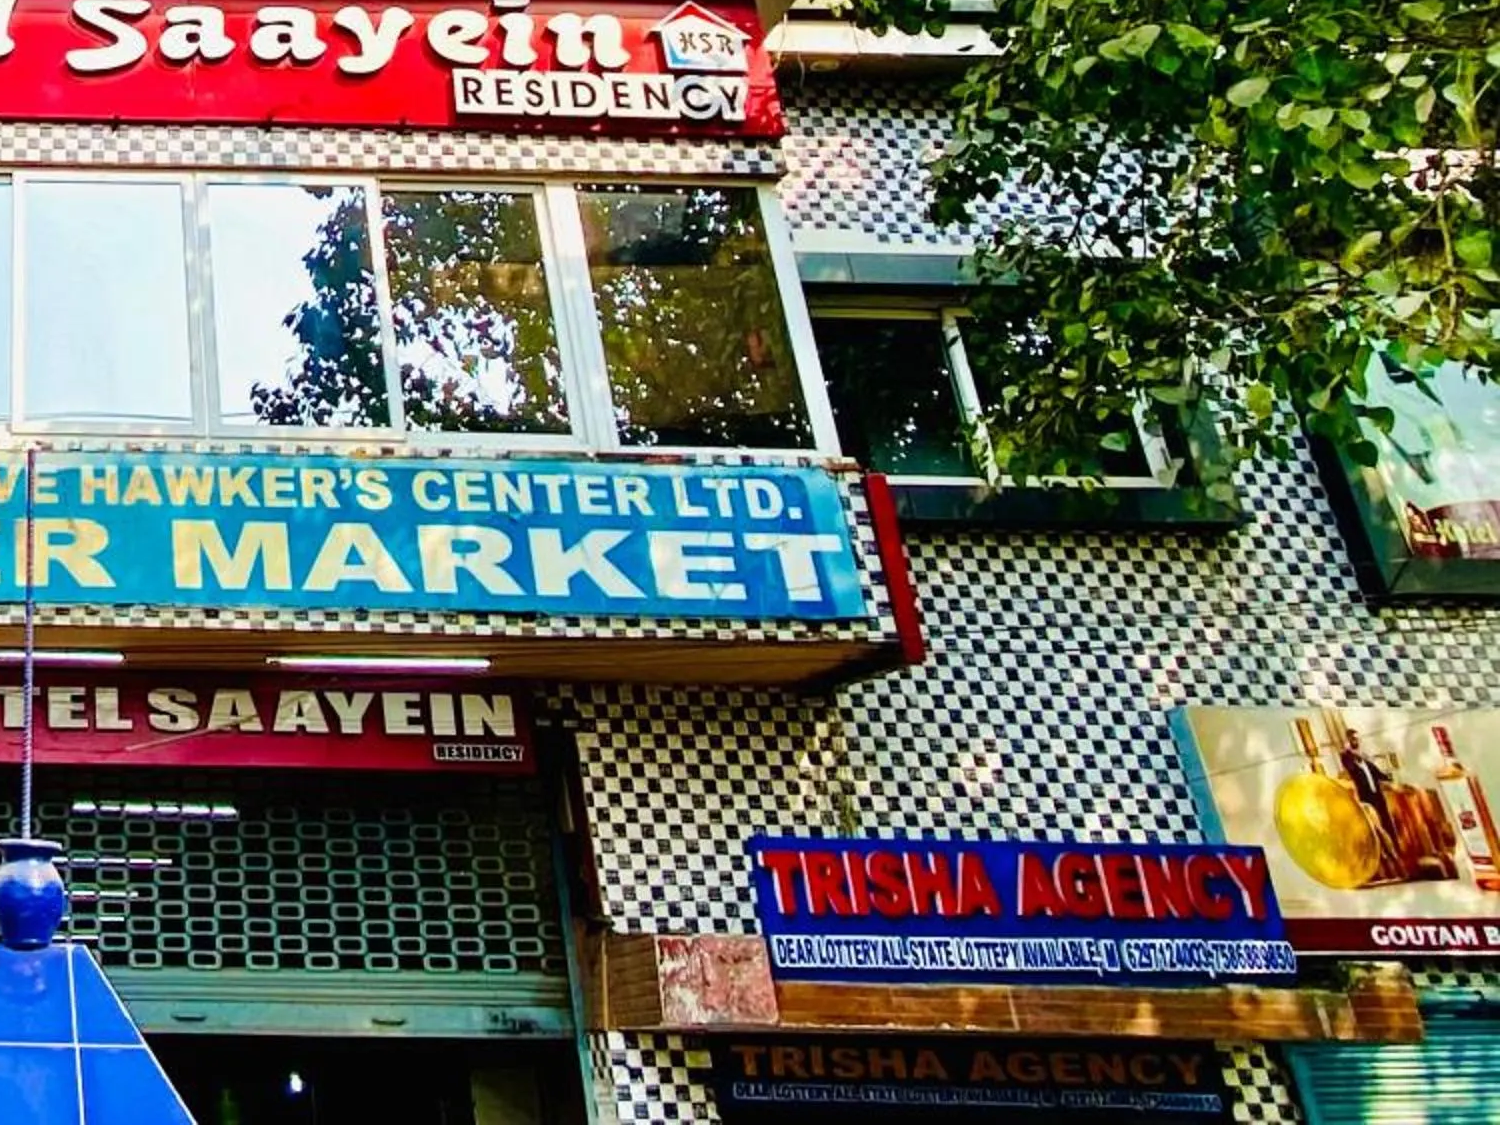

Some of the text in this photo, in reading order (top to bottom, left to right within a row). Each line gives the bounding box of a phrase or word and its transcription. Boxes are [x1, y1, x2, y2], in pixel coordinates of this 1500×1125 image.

[457, 73, 745, 116] RESIDENCY
[80, 465, 393, 507] HAWKER'S
[411, 469, 654, 517] CENTER
[673, 475, 802, 520] LTD.
[170, 519, 842, 603] MARKET
[149, 687, 517, 738] SAAYEIN
[434, 744, 523, 762] RESIDENCY
[757, 850, 1266, 922] TRISHA AGENCY
[775, 937, 815, 966] DEAR
[910, 938, 954, 968] STATE
[1371, 925, 1478, 946] GOUTAM
[730, 1045, 1200, 1085] TRISHA AGENCY
